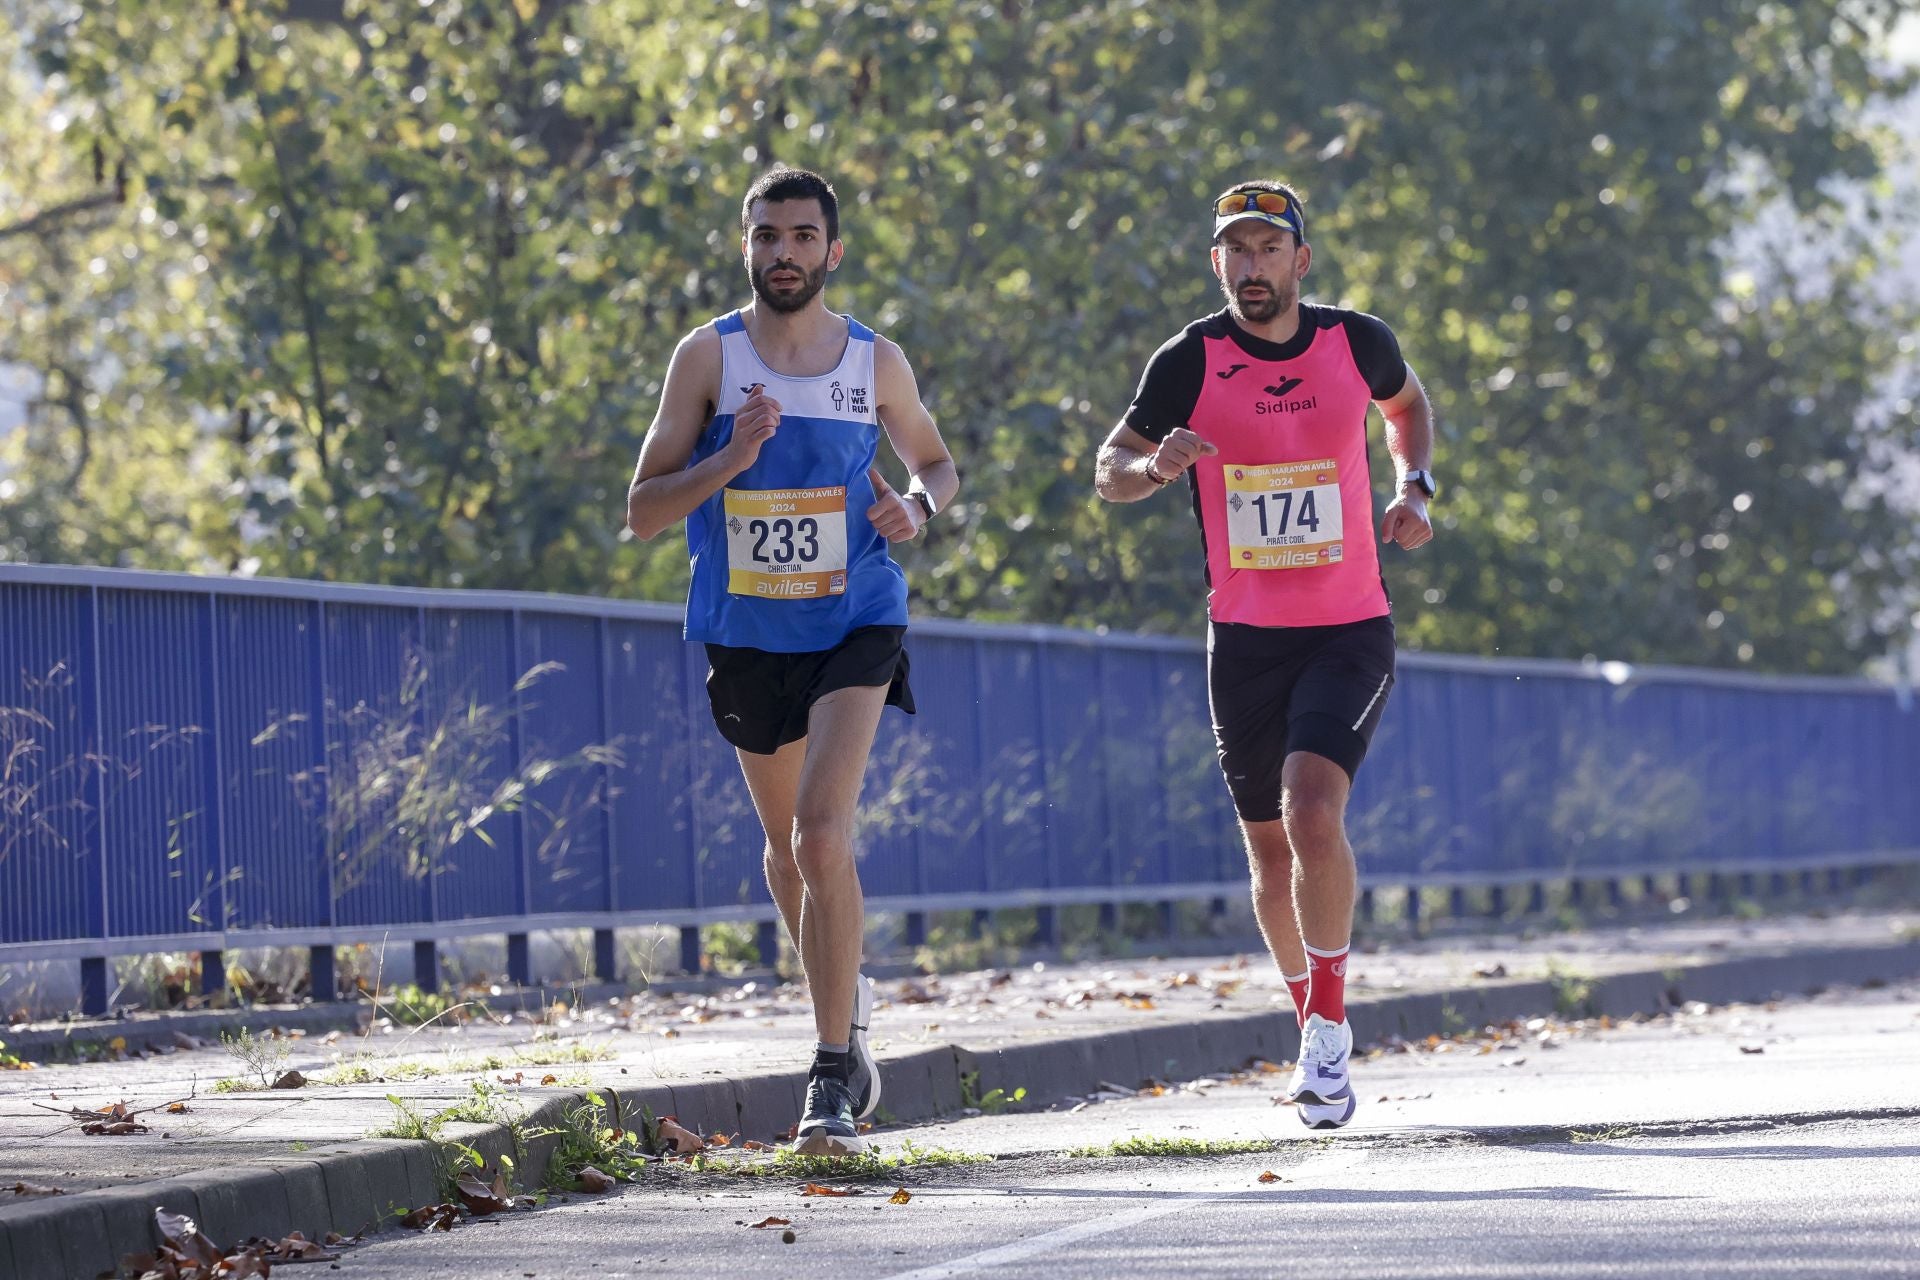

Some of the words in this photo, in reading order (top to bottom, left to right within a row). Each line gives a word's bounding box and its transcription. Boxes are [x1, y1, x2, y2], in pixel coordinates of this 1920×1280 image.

[851, 387, 866, 396] YES
[851, 396, 865, 404] WE
[1255, 395, 1317, 415] Sidipal
[852, 405, 869, 413] RUN
[1247, 468, 1270, 477] MEDIA
[1272, 464, 1311, 475] MARATÓN
[1311, 460, 1336, 470] AVILÉS
[1269, 477, 1294, 487] 2024
[747, 493, 771, 501] MEDIA
[773, 491, 814, 500] MARATÓN
[816, 488, 842, 497] AVILÉS
[769, 503, 796, 513] 2024
[1252, 490, 1319, 536] 174
[750, 517, 819, 563] 233
[1266, 535, 1288, 546] PIRATE
[1289, 534, 1306, 544] CODE
[1257, 549, 1318, 567] avilés
[768, 563, 802, 573] CHRISTIAN
[756, 579, 818, 595] avilés
